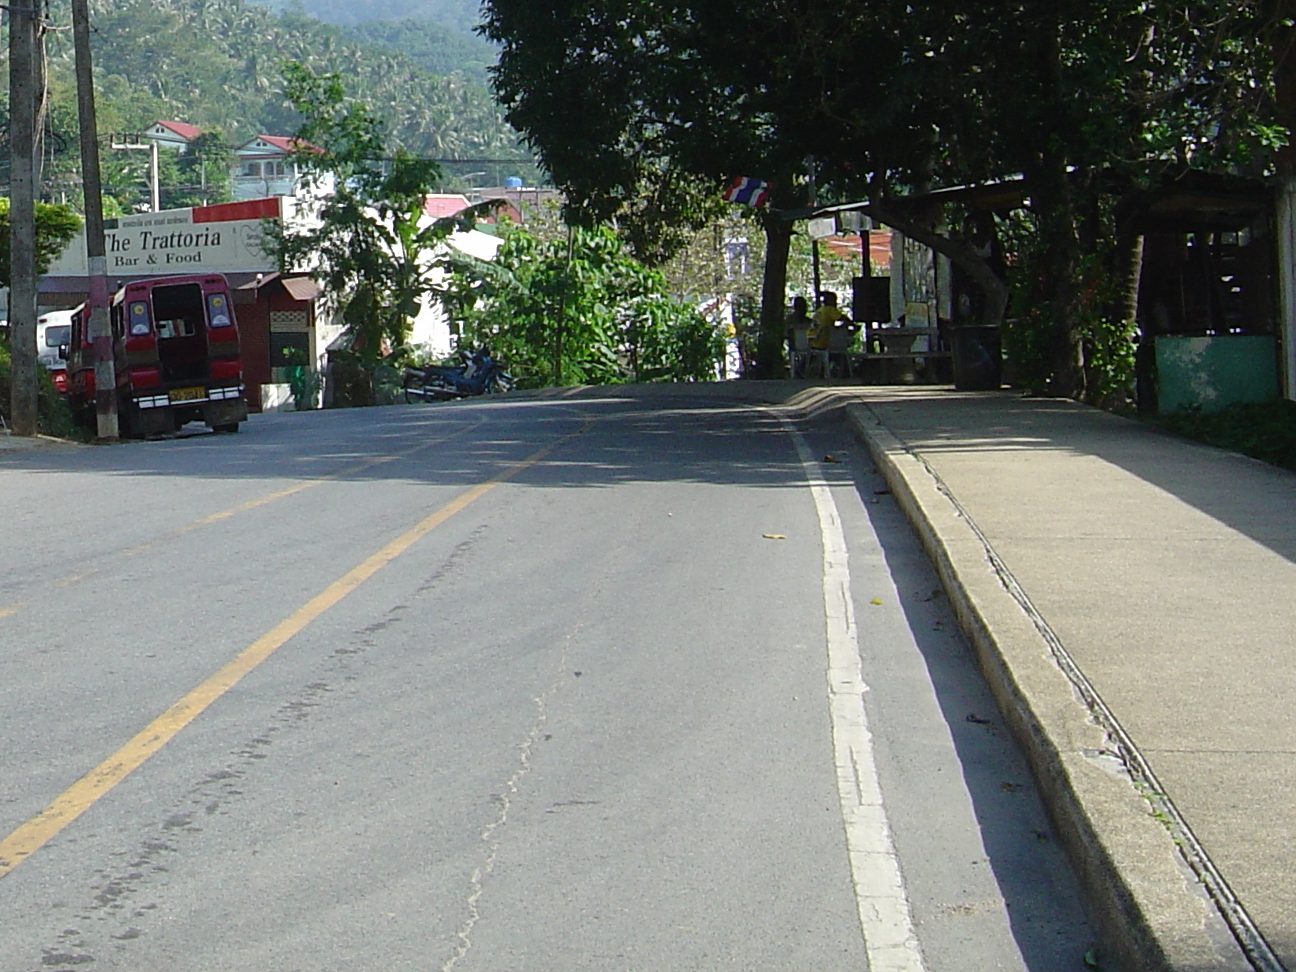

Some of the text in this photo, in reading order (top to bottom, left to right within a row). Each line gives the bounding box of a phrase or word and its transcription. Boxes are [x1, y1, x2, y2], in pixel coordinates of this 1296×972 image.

[140, 227, 221, 250] Trattoria
[114, 252, 202, 266] Bar & Food
